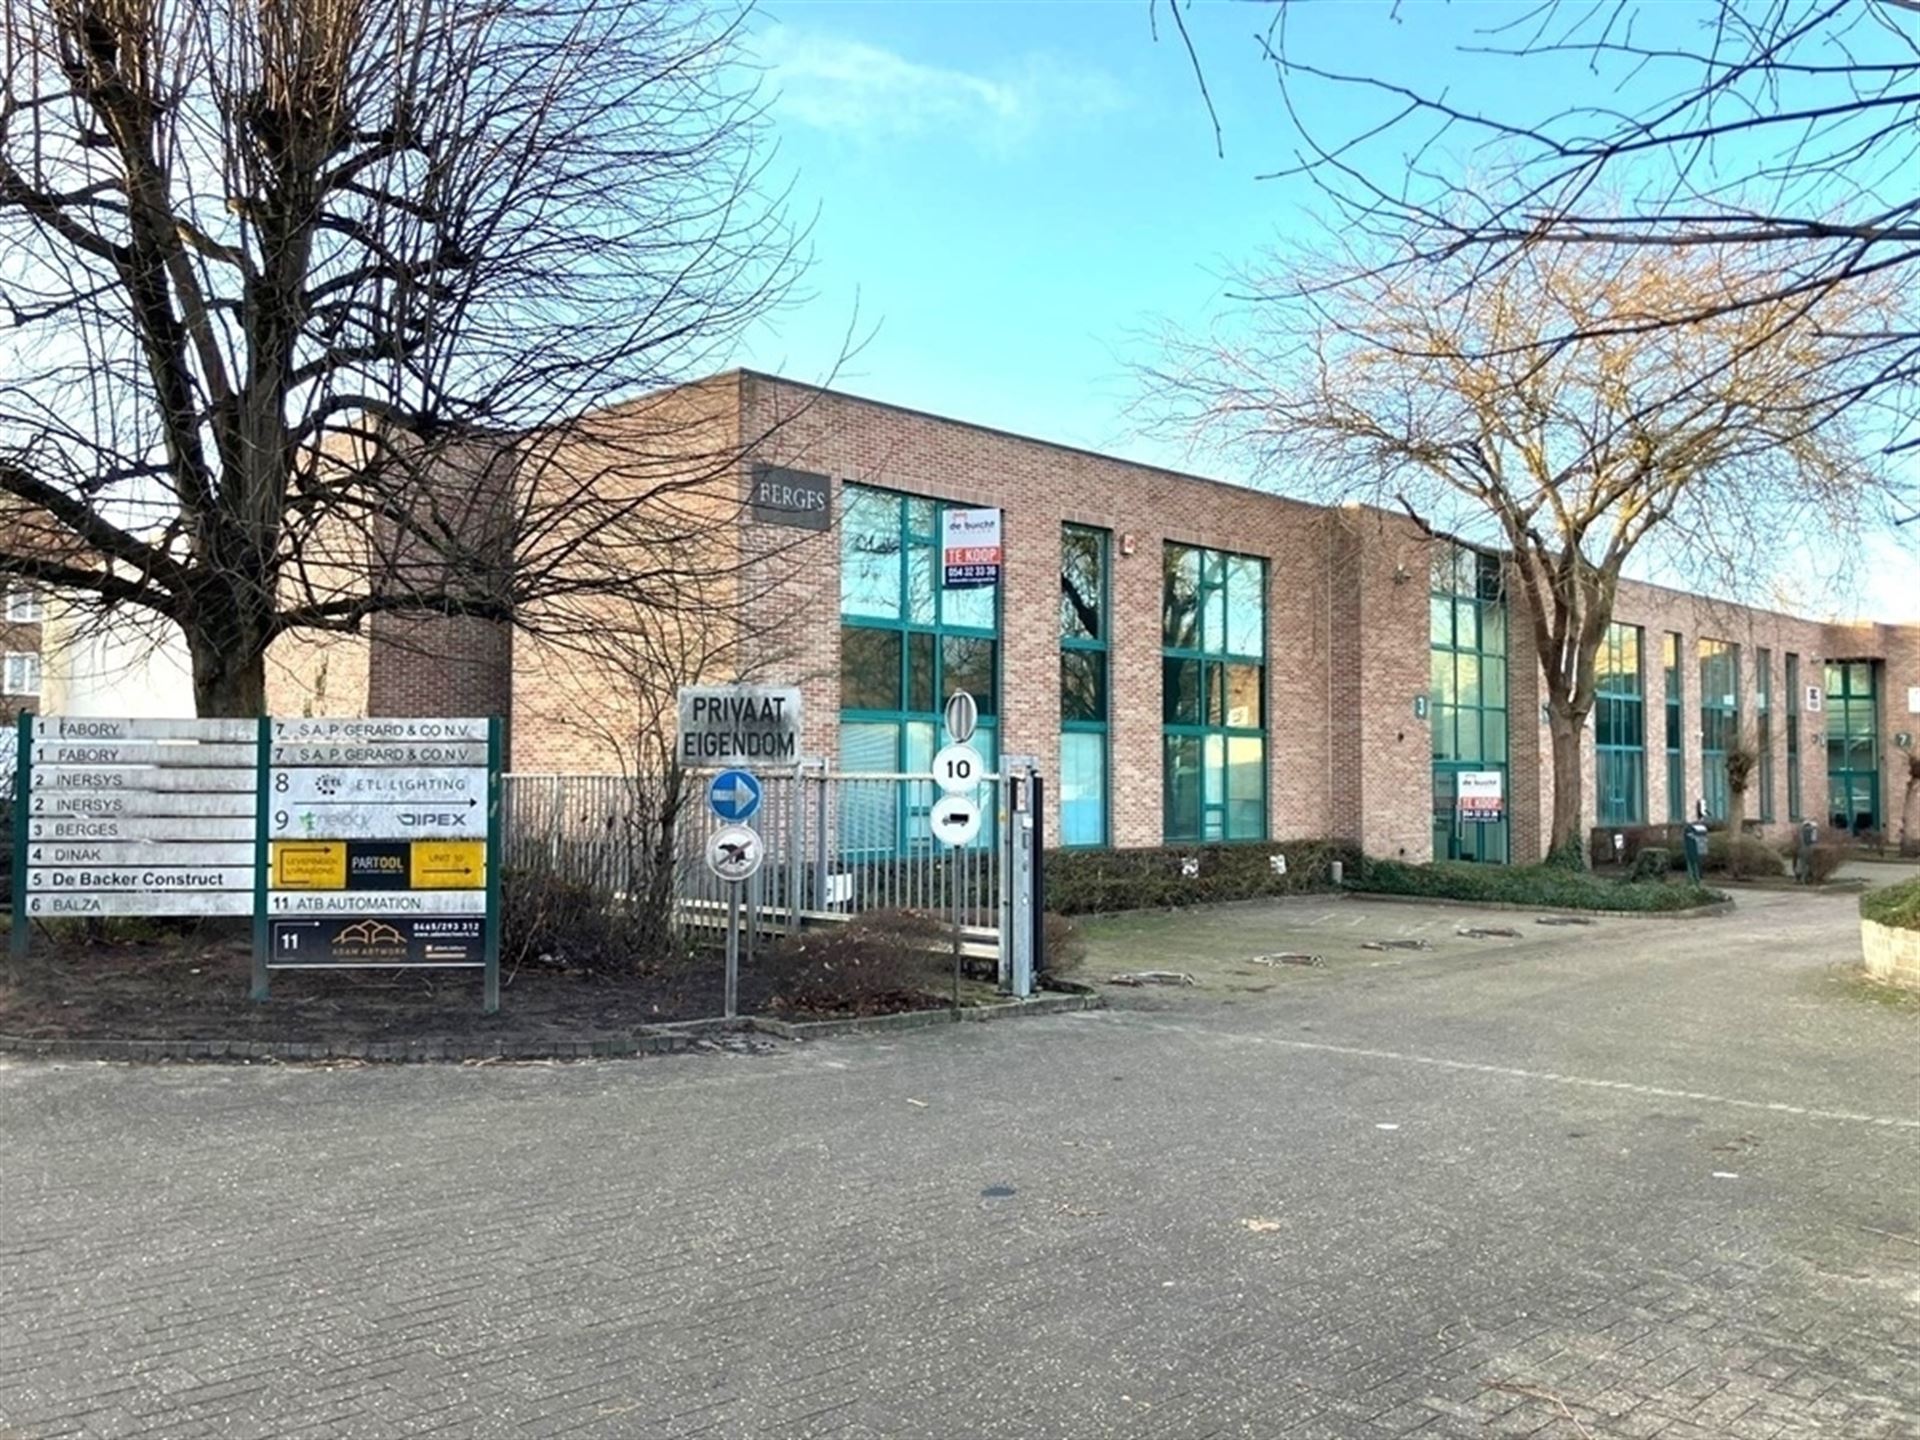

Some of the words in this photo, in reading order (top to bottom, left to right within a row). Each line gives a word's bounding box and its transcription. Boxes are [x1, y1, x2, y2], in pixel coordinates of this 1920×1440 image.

[759, 482, 825, 512] BERGES
[948, 549, 963, 563] TE
[965, 548, 996, 562] KOOP
[693, 697, 786, 723] PRIVAAT
[38, 722, 45, 734] 1
[59, 722, 120, 735] FABORY
[275, 723, 284, 735] 7
[344, 723, 404, 736] GERARD
[407, 724, 416, 736] &
[684, 731, 795, 756] EIGENDOM
[37, 749, 44, 760] 1
[58, 749, 119, 760] FABORY
[274, 748, 284, 760] 7
[344, 748, 404, 761] GERARD
[408, 749, 416, 761] &
[946, 760, 971, 778] 10
[35, 774, 44, 786] 2
[56, 774, 123, 786] INERSYS
[275, 773, 289, 793] 8
[356, 779, 383, 790] ETL
[390, 778, 466, 790] LIGHTING
[35, 799, 44, 811] 2
[56, 799, 123, 811] INERSYS
[275, 811, 289, 830] 9
[34, 824, 42, 836] 3
[55, 824, 118, 836] BERGES
[32, 849, 42, 860] 4
[54, 849, 101, 860] DINAK
[352, 856, 404, 869] PARTOOL
[33, 874, 42, 885] 5
[53, 873, 75, 886] De
[80, 873, 138, 886] Backer
[143, 872, 223, 886] Construct
[31, 899, 40, 911] 6
[53, 899, 101, 911] BALZA
[273, 897, 289, 909] 11
[296, 897, 327, 909] ATB
[328, 897, 422, 909] AUTOMATION
[281, 933, 298, 950] 11
